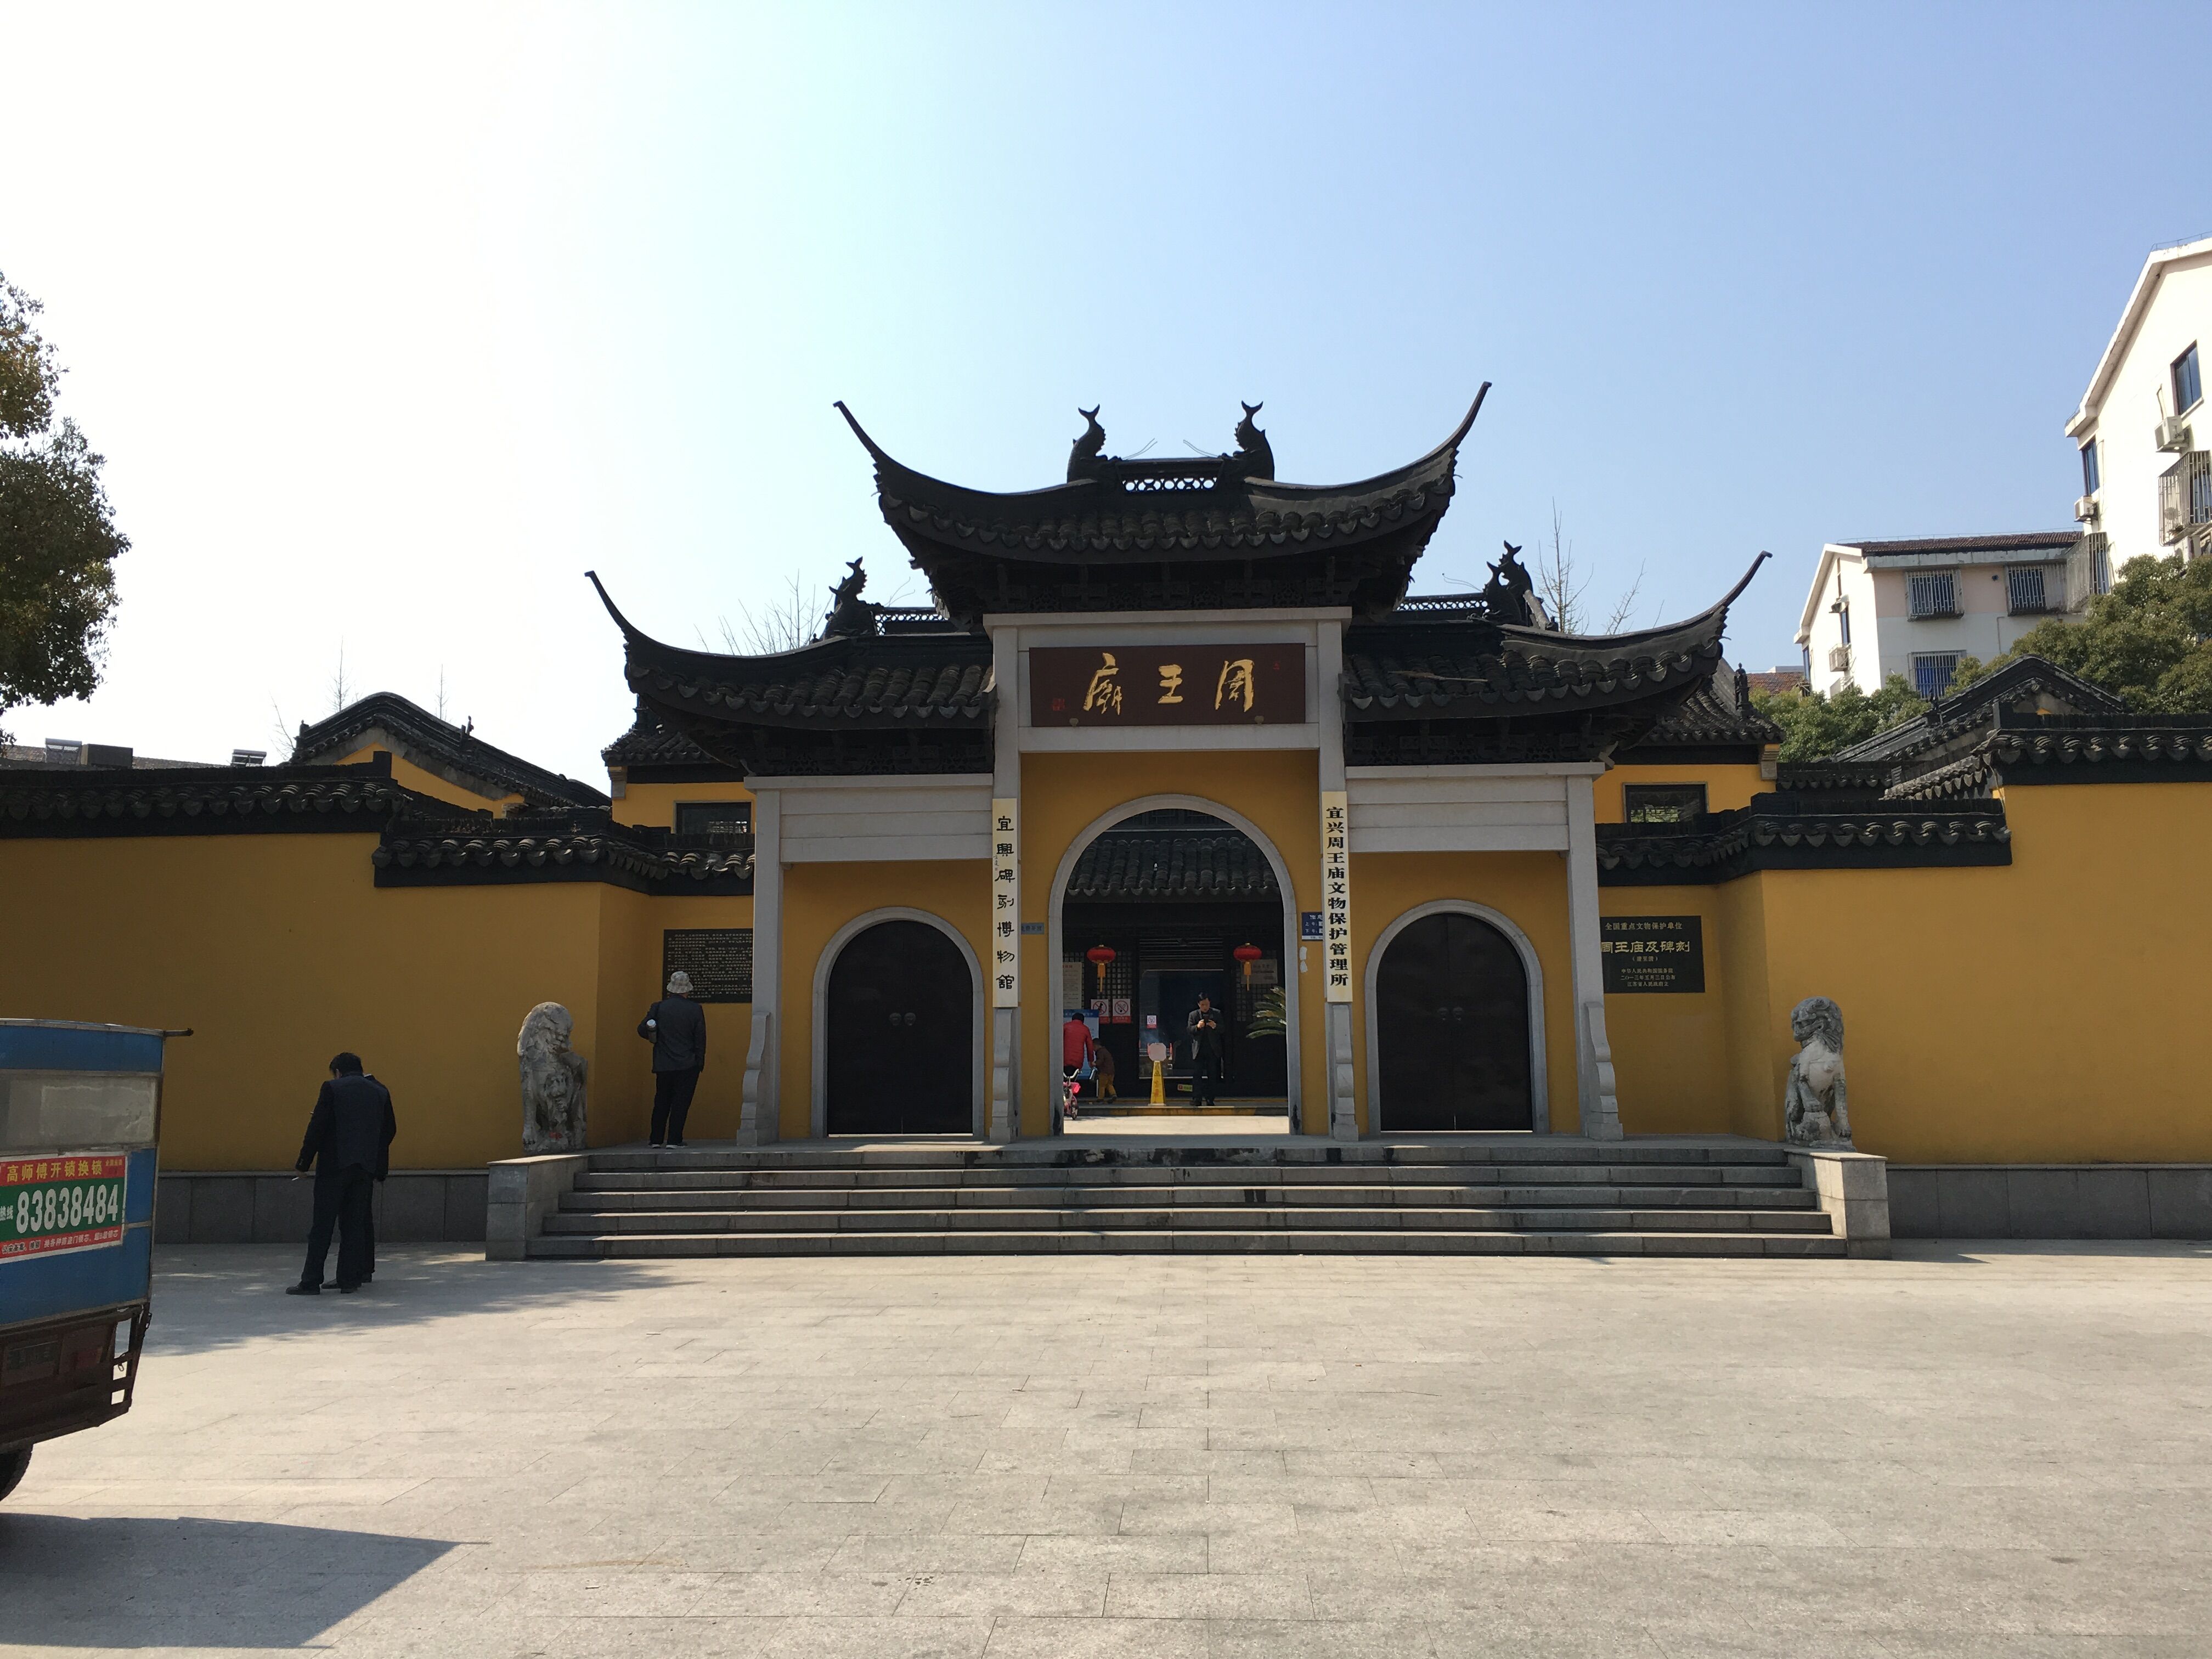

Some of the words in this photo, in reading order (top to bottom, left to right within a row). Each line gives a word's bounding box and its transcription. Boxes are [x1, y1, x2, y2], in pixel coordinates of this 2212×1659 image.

[1326, 806, 1348, 986] 宜兴周王庙文物保护管理所
[1605, 922, 1683, 930] 全国重点文物保护单位
[1601, 941, 1690, 953] 周王庙及碑刻
[7, 1160, 102, 1182] 高师傅开锁换锁
[16, 1184, 118, 1233] 83838484
